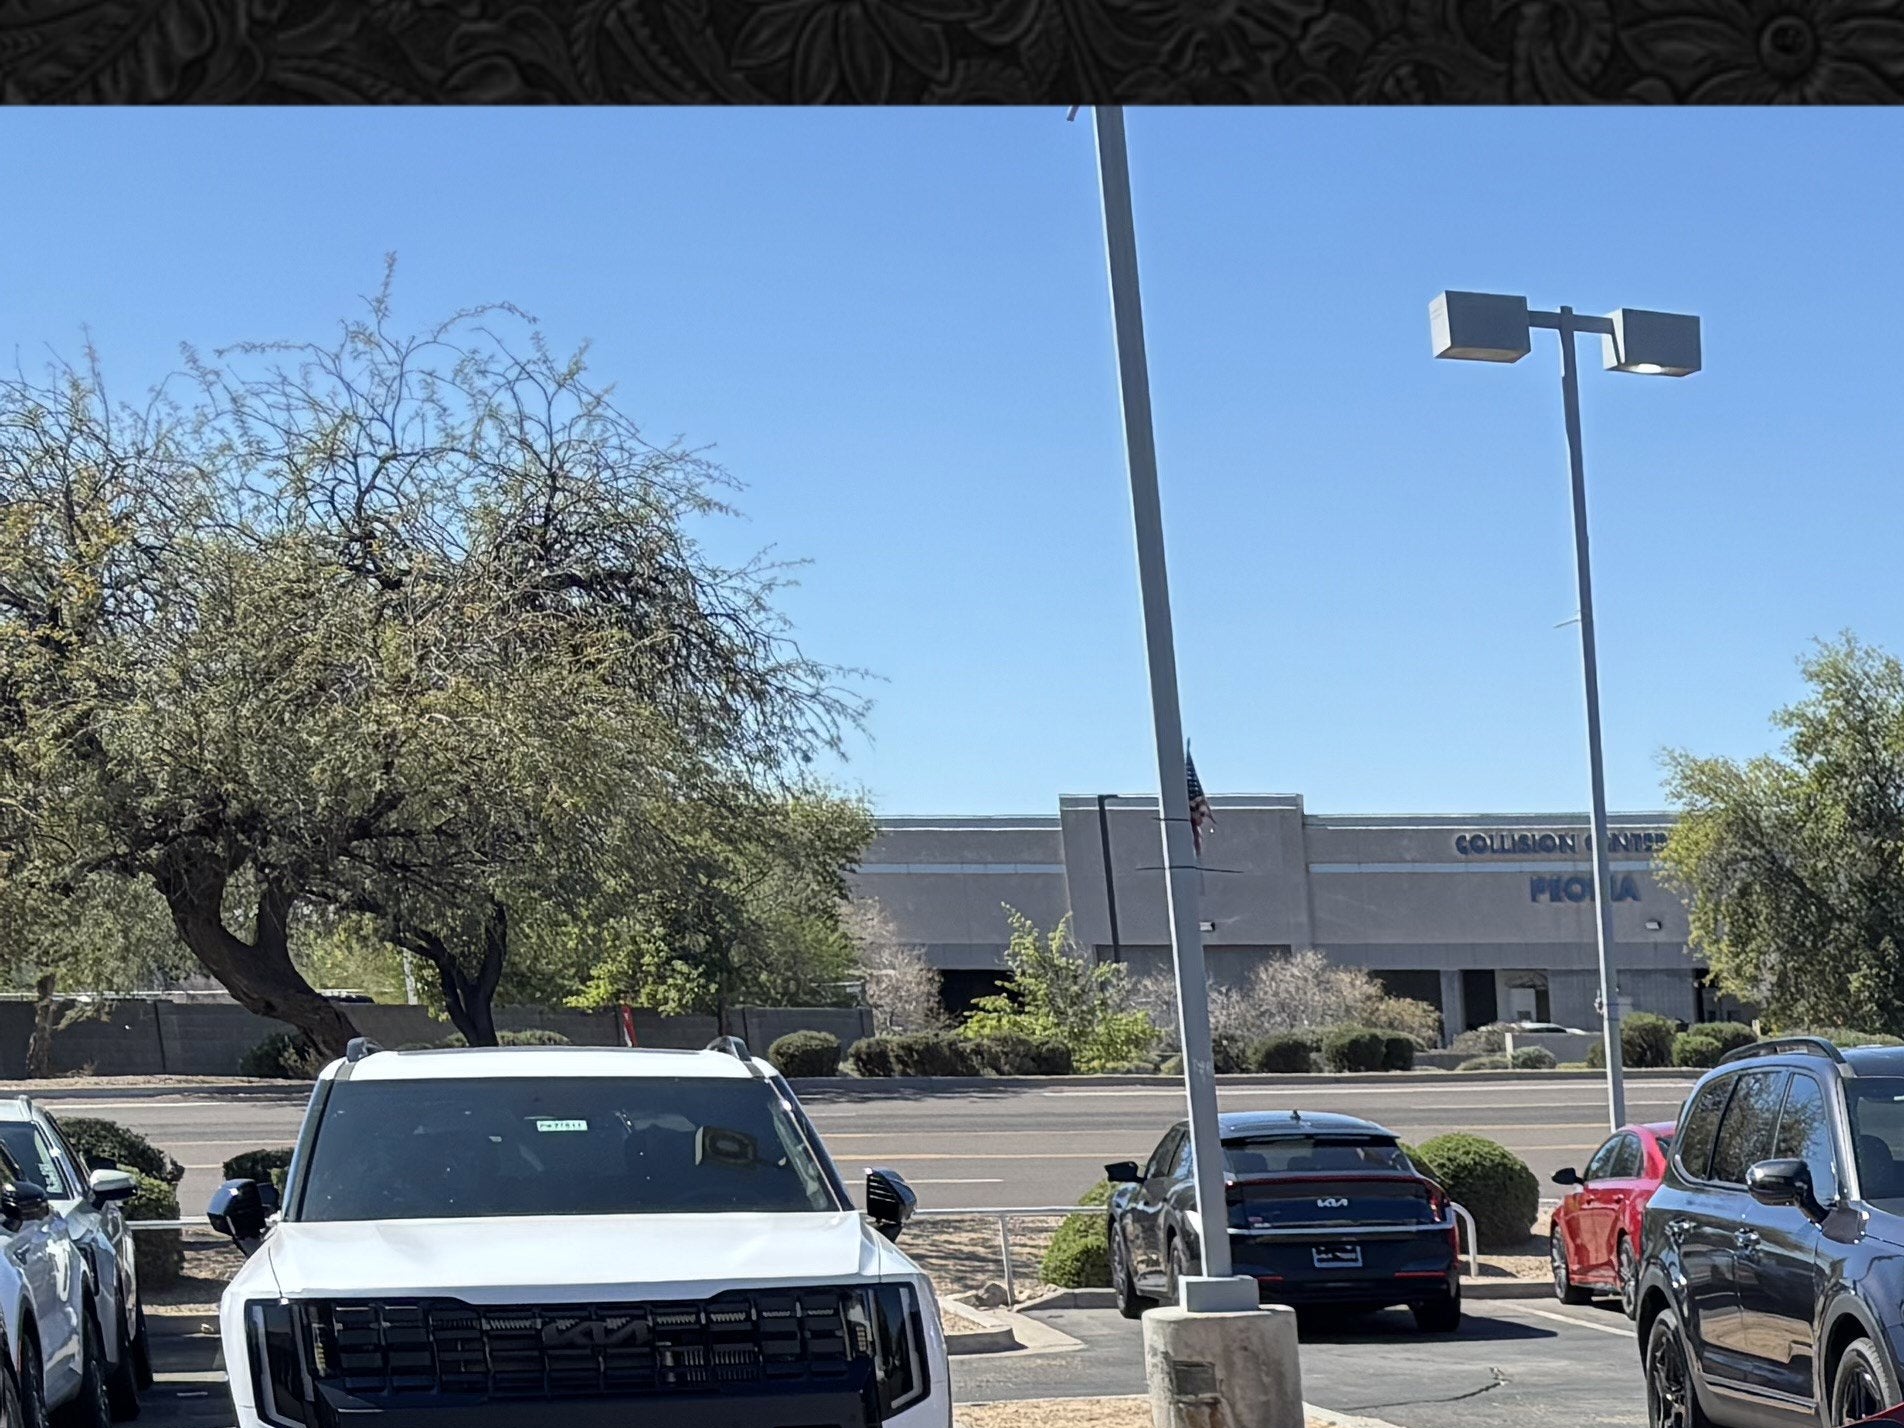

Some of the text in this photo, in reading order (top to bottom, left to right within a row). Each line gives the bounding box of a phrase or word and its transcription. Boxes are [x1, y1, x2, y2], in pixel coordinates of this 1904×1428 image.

[1455, 831, 1668, 854] COLLISION CNTER
[1530, 875, 1641, 902] PEOIA
